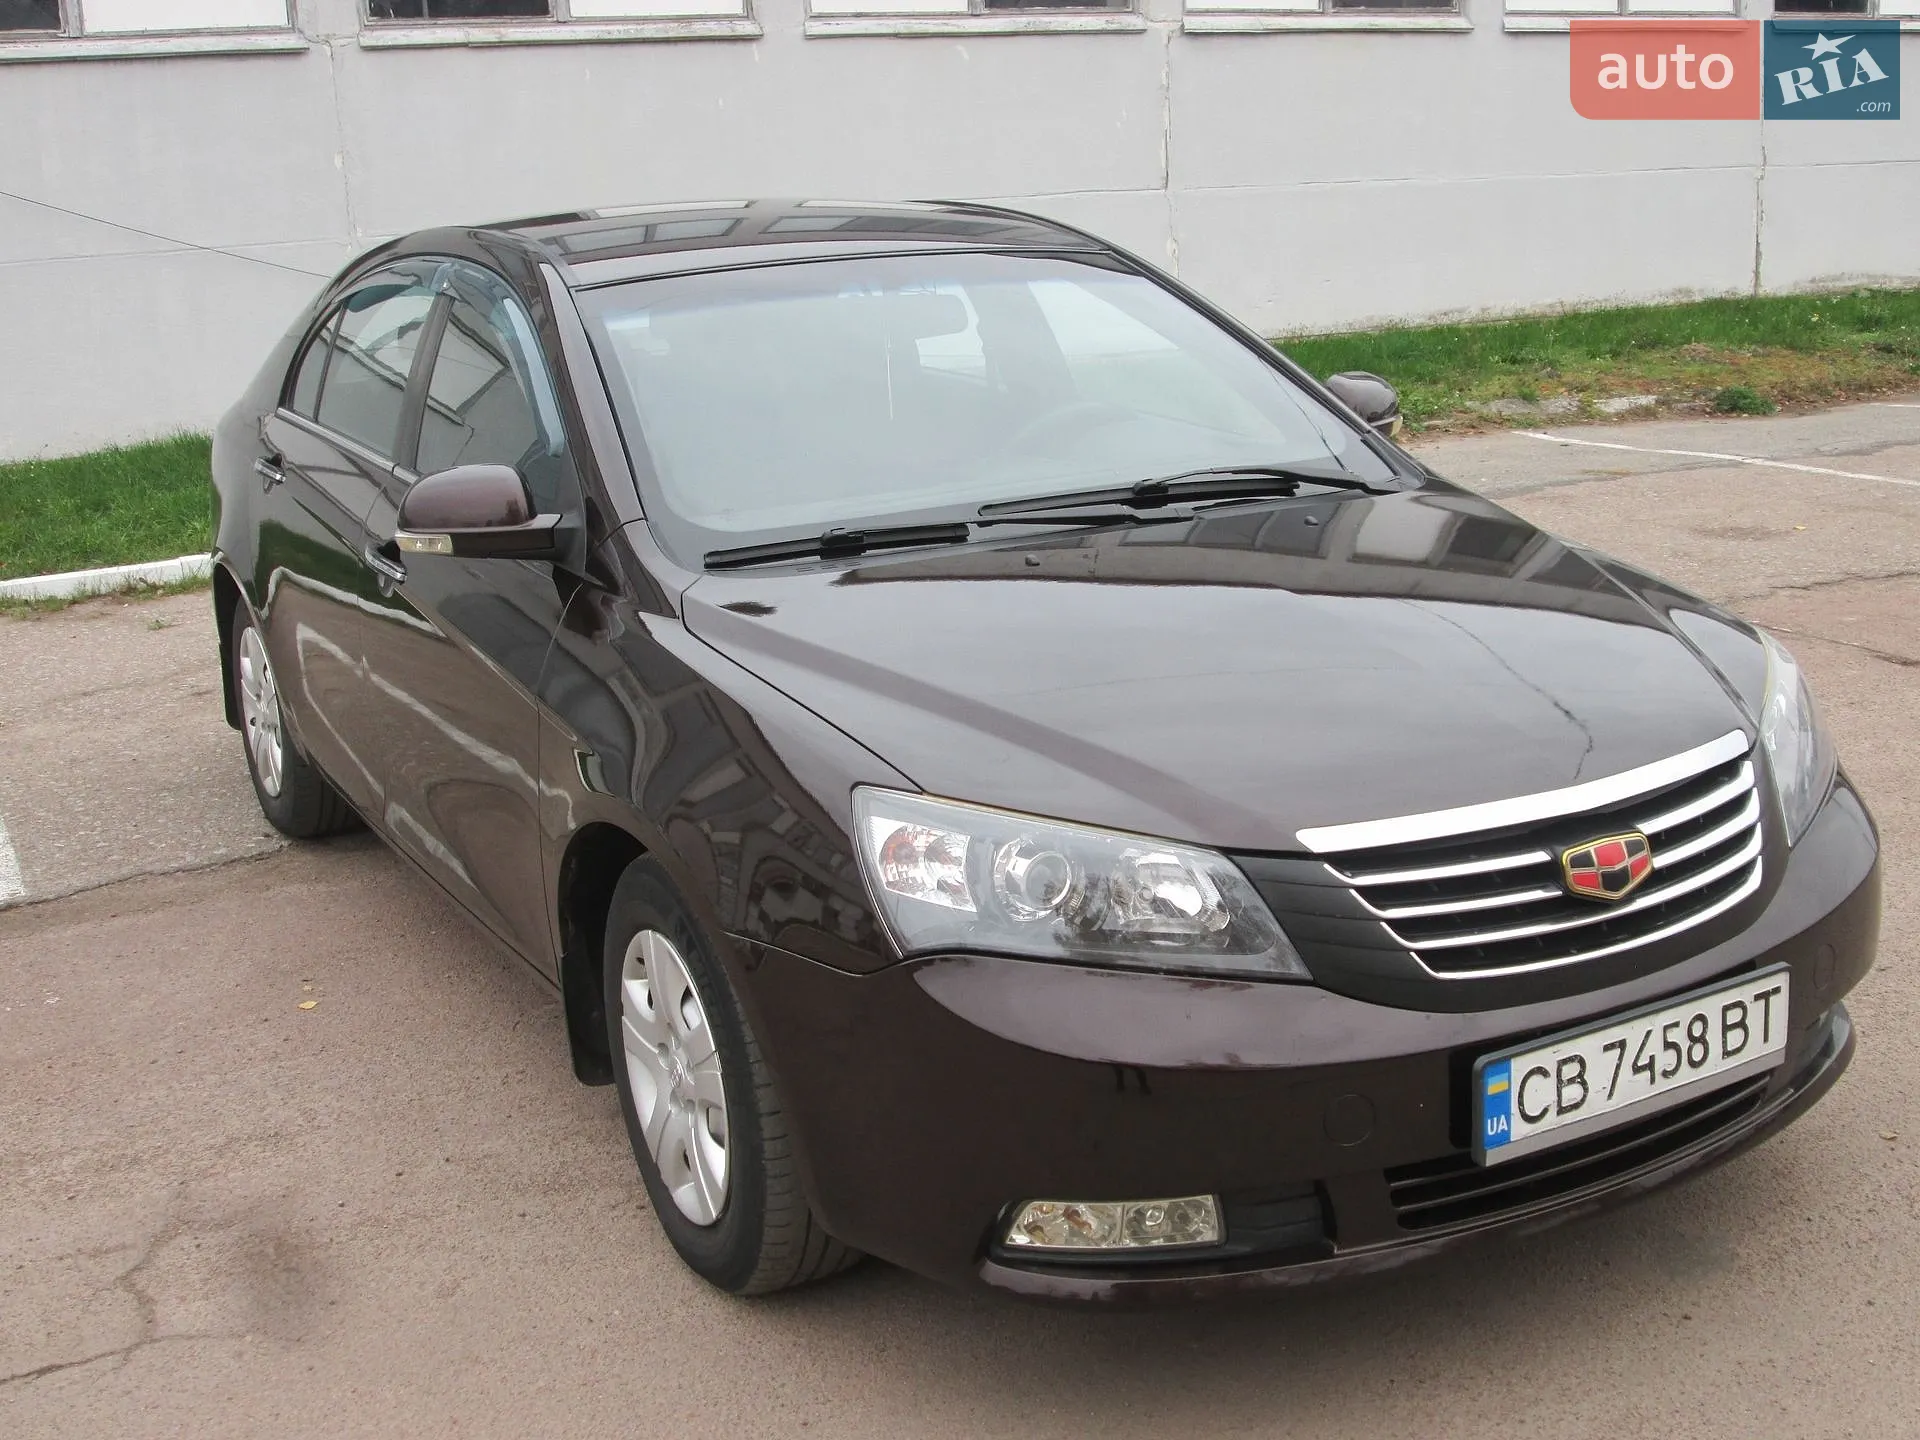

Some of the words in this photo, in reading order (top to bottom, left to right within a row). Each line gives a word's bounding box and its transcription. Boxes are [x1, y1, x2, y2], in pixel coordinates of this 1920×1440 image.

[1517, 1054, 1589, 1124] CB
[1602, 1013, 1709, 1101] 7458
[1721, 986, 1782, 1060] BT
[1487, 1116, 1508, 1136] UA
